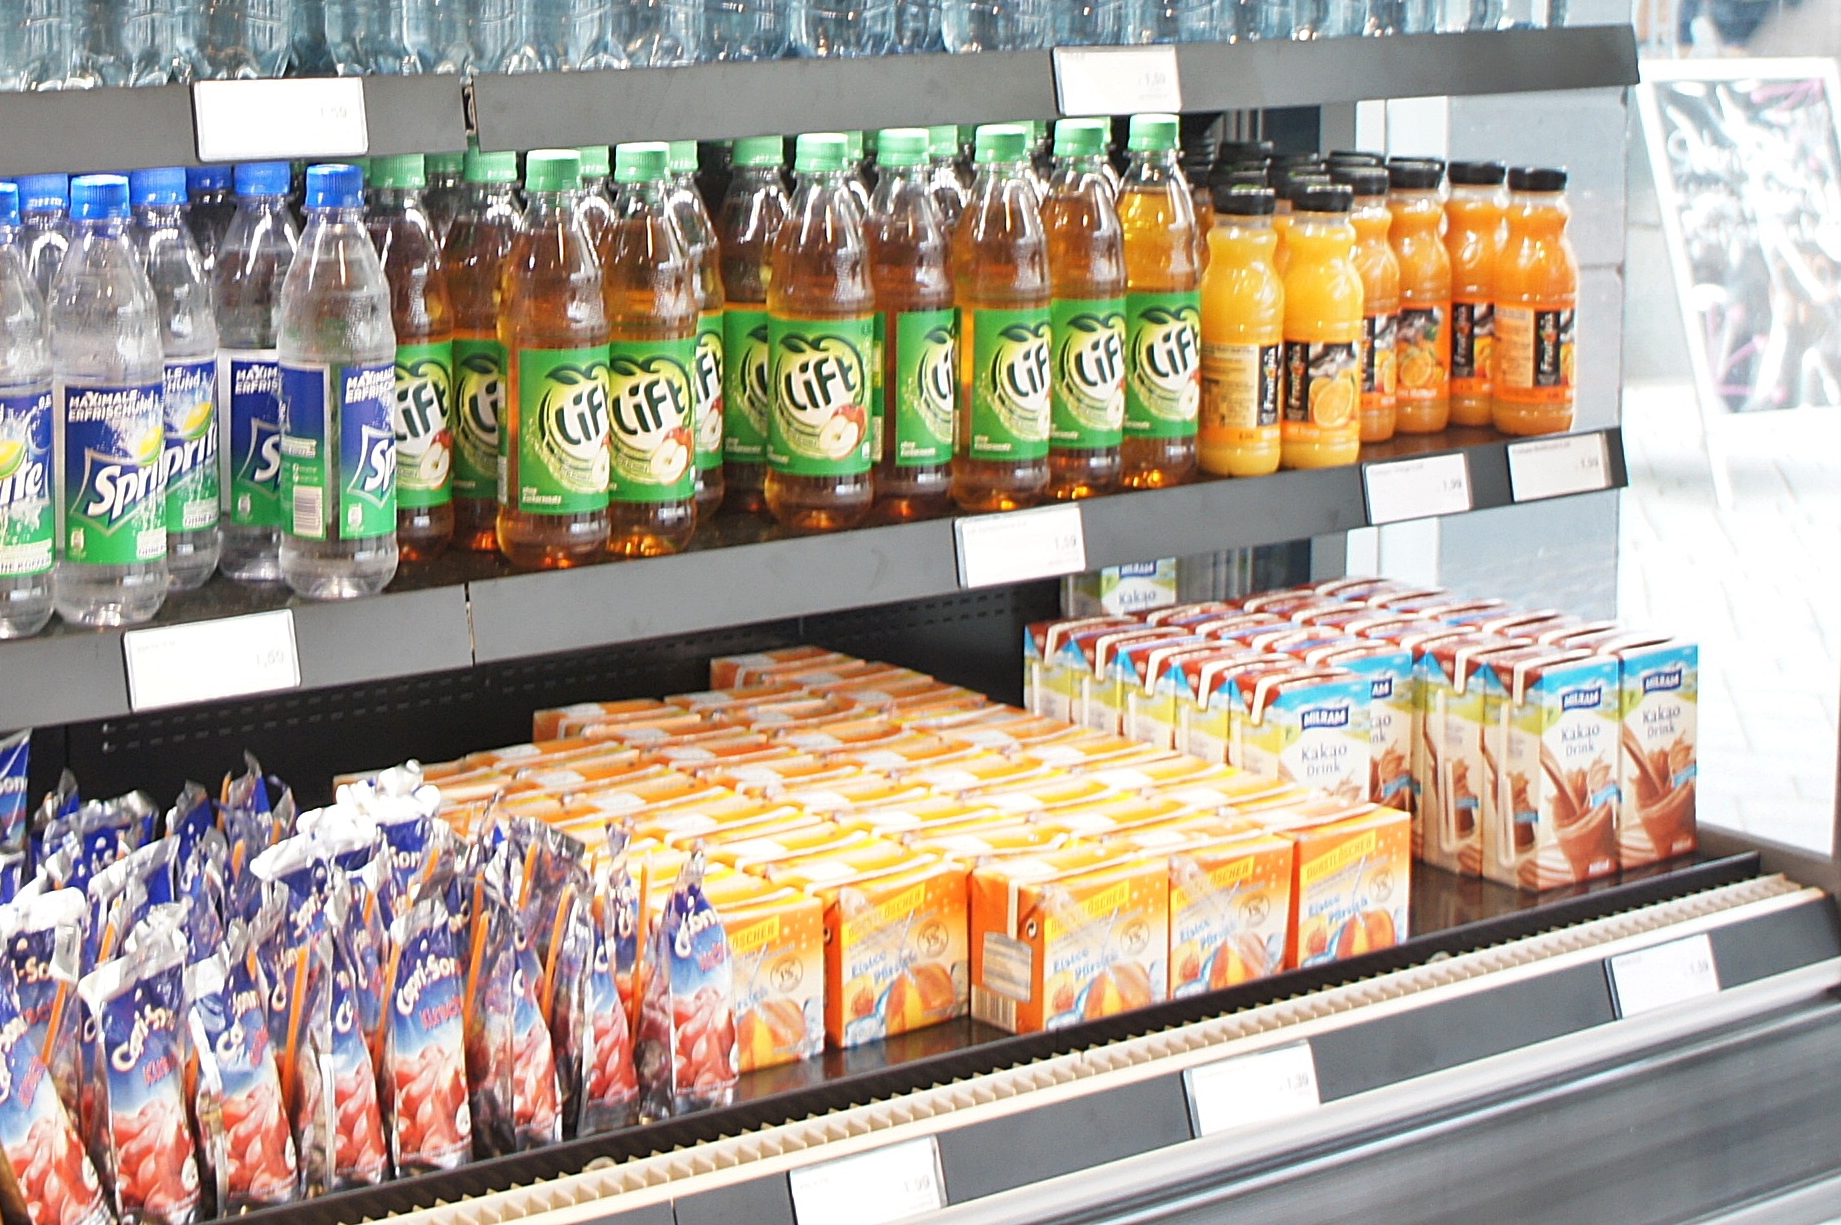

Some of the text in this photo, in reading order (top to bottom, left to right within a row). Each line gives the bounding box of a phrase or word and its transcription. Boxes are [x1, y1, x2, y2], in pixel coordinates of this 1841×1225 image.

[1302, 708, 1347, 726] MILRAM
[1643, 705, 1680, 724] Kakao
[1561, 724, 1600, 742] Kakao
[1648, 723, 1675, 739] Drink
[1301, 743, 1348, 760] Kakao
[1566, 742, 1595, 757] Drink
[1307, 761, 1342, 775] Drink
